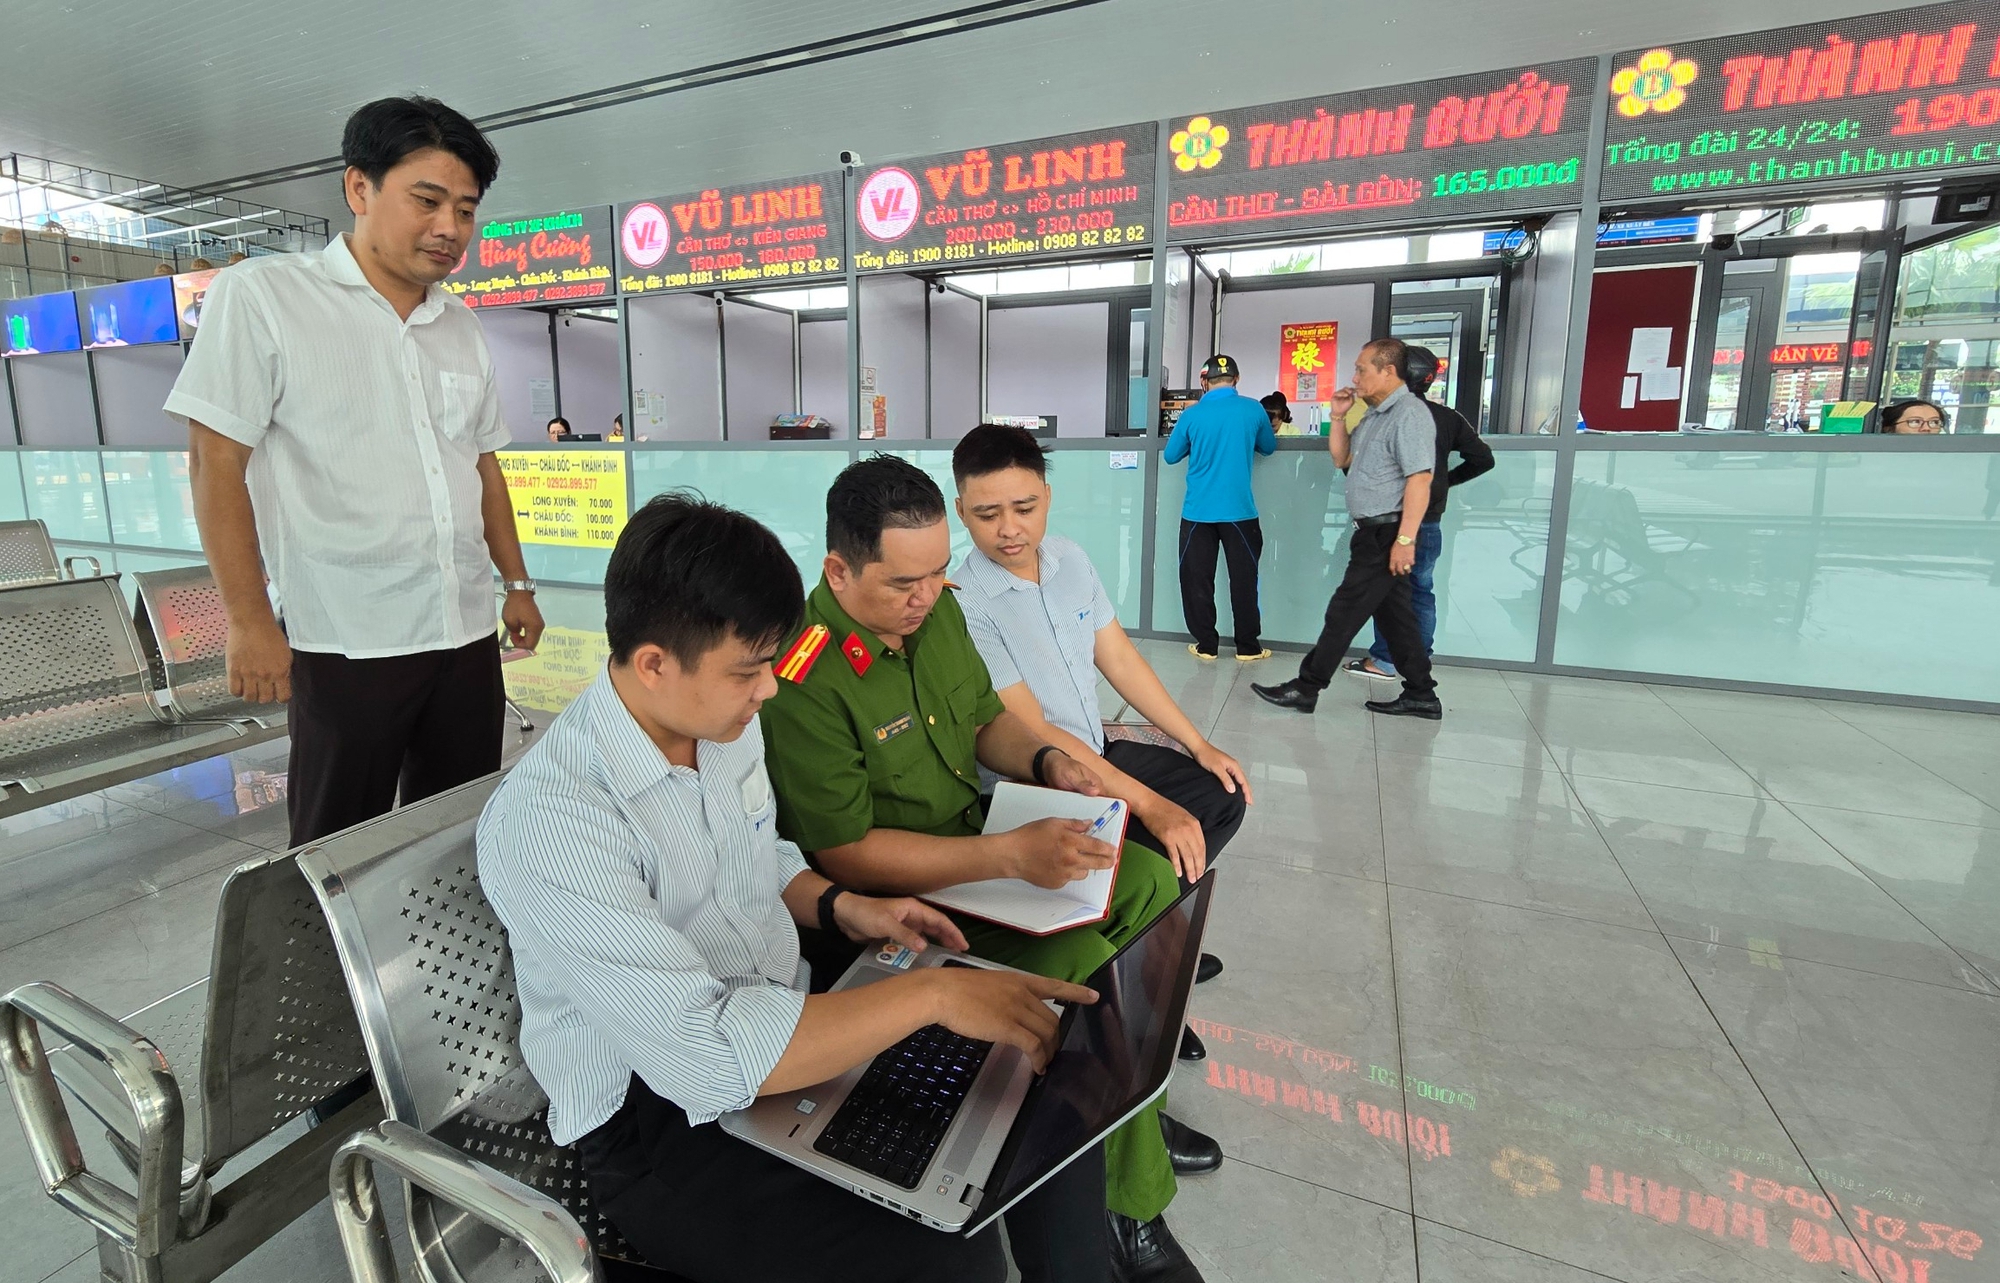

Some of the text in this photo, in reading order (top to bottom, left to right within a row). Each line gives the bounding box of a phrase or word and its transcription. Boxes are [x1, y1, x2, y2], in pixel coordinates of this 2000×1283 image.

[1722, 23, 1977, 112] THÀNH
[1246, 71, 1571, 170] THÀNH BƯỞI
[1690, 130, 1739, 157] đài
[1747, 117, 1861, 151] 24/24:
[924, 140, 1127, 201] VŨ LINH
[1432, 157, 1580, 200] 165.000đ
[1652, 140, 2000, 192] www.thanhbuoi.c
[671, 184, 823, 234] VŨ LINH
[925, 205, 959, 227] CẦN
[962, 199, 998, 223] THƠ
[1027, 192, 1051, 215] HỒ
[1055, 186, 1087, 210] CHÍ
[1090, 185, 1138, 207] MINH
[1169, 195, 1218, 223] CẦN
[1225, 191, 1279, 217] THƠ
[1302, 180, 1350, 209] SÀI
[482, 211, 583, 239] CÔNG TY XE KHÁCH
[705, 233, 732, 251] THƠ
[753, 226, 782, 246] KIÊN
[784, 224, 827, 242] GIANG
[912, 244, 942, 262] 1900
[944, 243, 975, 260] 8181
[988, 237, 1040, 257] Hotline:
[1043, 231, 1078, 251] 0908
[1081, 229, 1100, 246] 82
[1103, 227, 1122, 244] 82
[1126, 225, 1145, 241] 82
[945, 221, 1016, 246] 200.000
[1037, 210, 1114, 236] 230.000
[479, 238, 529, 272] Hùng
[665, 273, 688, 287] 1900
[689, 270, 714, 286] 8181
[722, 266, 762, 283] Hotline:
[763, 262, 790, 278] 0908
[791, 260, 806, 275] 82
[808, 258, 823, 273] 82
[824, 256, 840, 271] 82
[689, 252, 744, 272] 150.000
[758, 244, 816, 264] 180.000
[532, 496, 551, 506] LONG
[589, 499, 613, 508] 70.000
[586, 514, 613, 524] 100.000
[587, 529, 614, 540] 110.000
